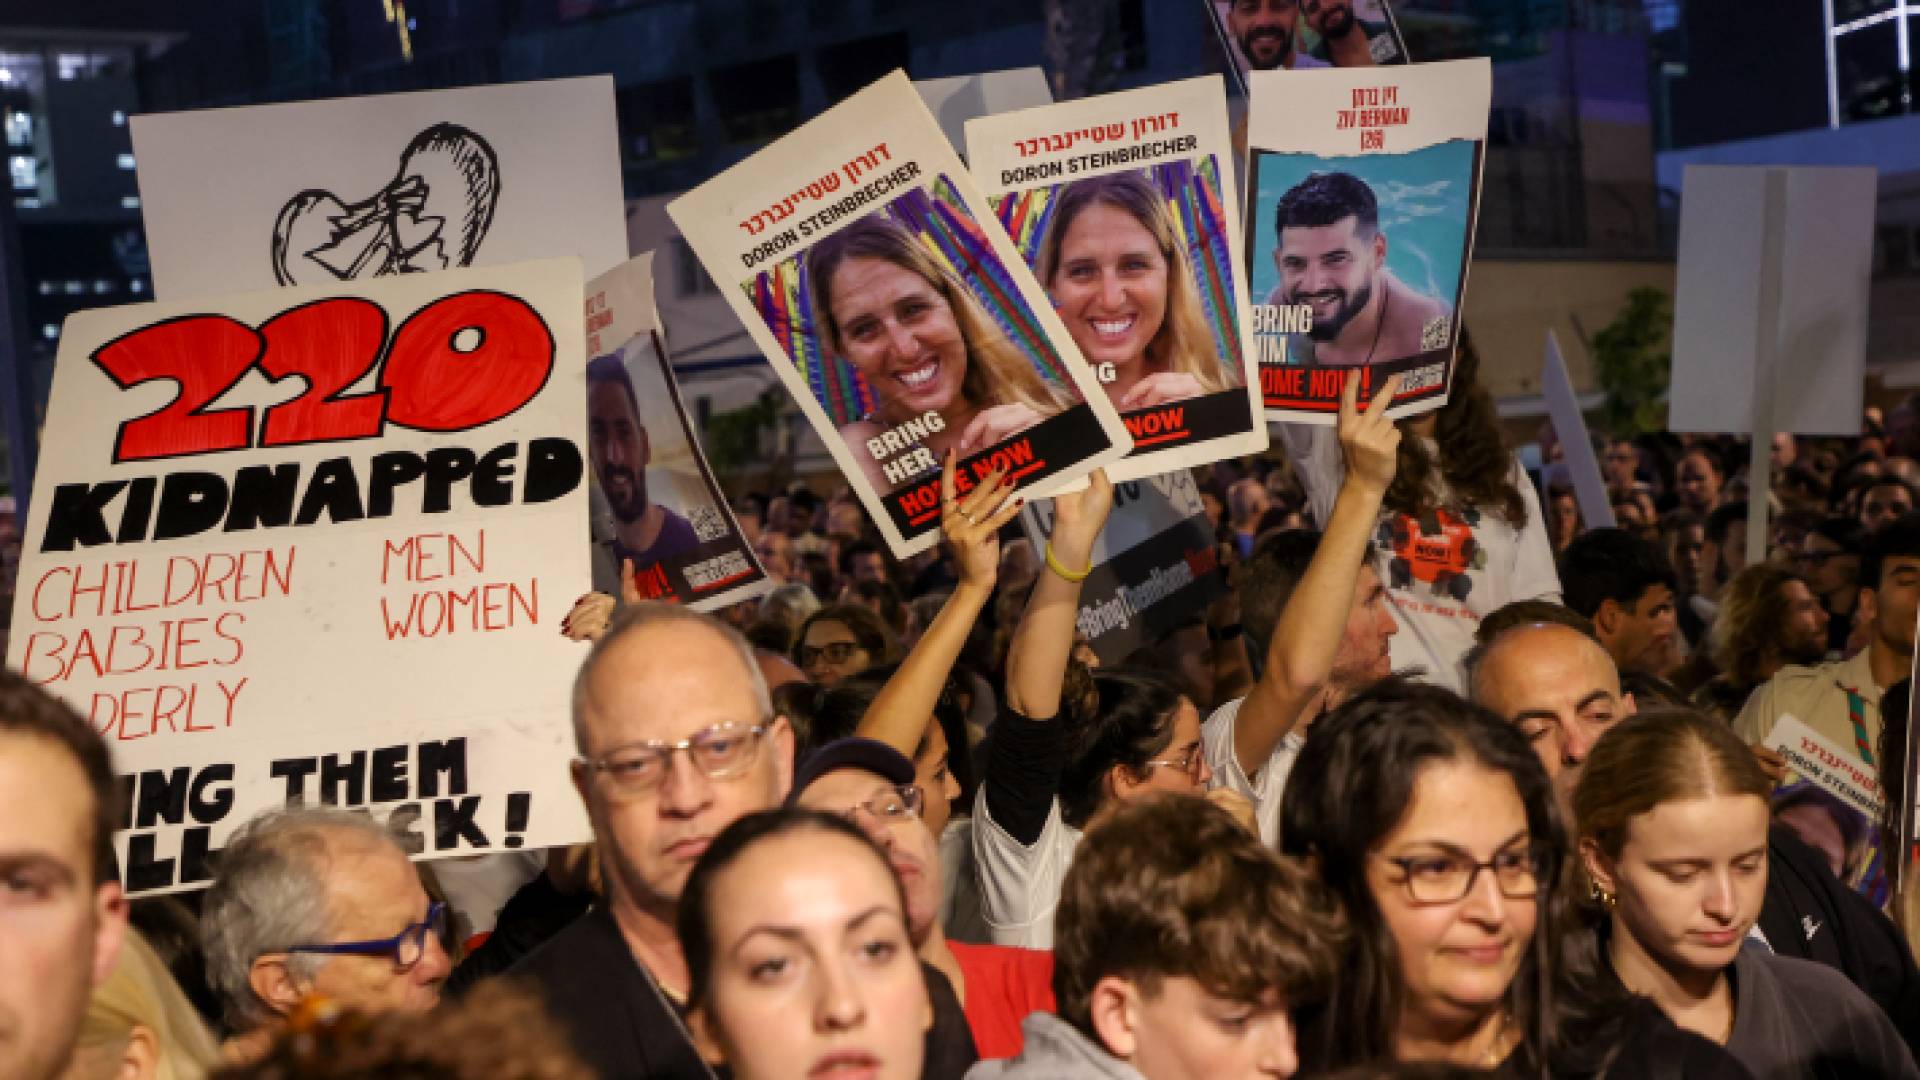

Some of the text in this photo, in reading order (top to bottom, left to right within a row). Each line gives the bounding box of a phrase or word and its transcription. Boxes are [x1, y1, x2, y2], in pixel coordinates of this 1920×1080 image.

[1014, 112, 1179, 157] דורון שטיינברכר
[1360, 107, 1409, 127] BERMAN
[739, 142, 891, 236] דורון שטיינברכר
[1001, 134, 1197, 186] DORON STEINBRECHER
[740, 161, 922, 268] DORON STEINBRECHER
[89, 290, 556, 464] 220
[1261, 366, 1306, 396] OME
[1309, 364, 1370, 400] NO!
[867, 410, 945, 460] BRING
[1124, 407, 1184, 437] NOW
[40, 437, 584, 553] KIDNAPPED
[883, 447, 938, 484] HER
[899, 437, 1034, 517] HOE NOW
[32, 545, 296, 622] CHILDREN
[381, 528, 485, 585] MEN
[381, 577, 539, 640] WOMEN
[23, 612, 247, 685] BABIES
[88, 677, 249, 740] DERLY
[117, 736, 468, 829] ING THEM
[126, 792, 531, 893] LL CK!
